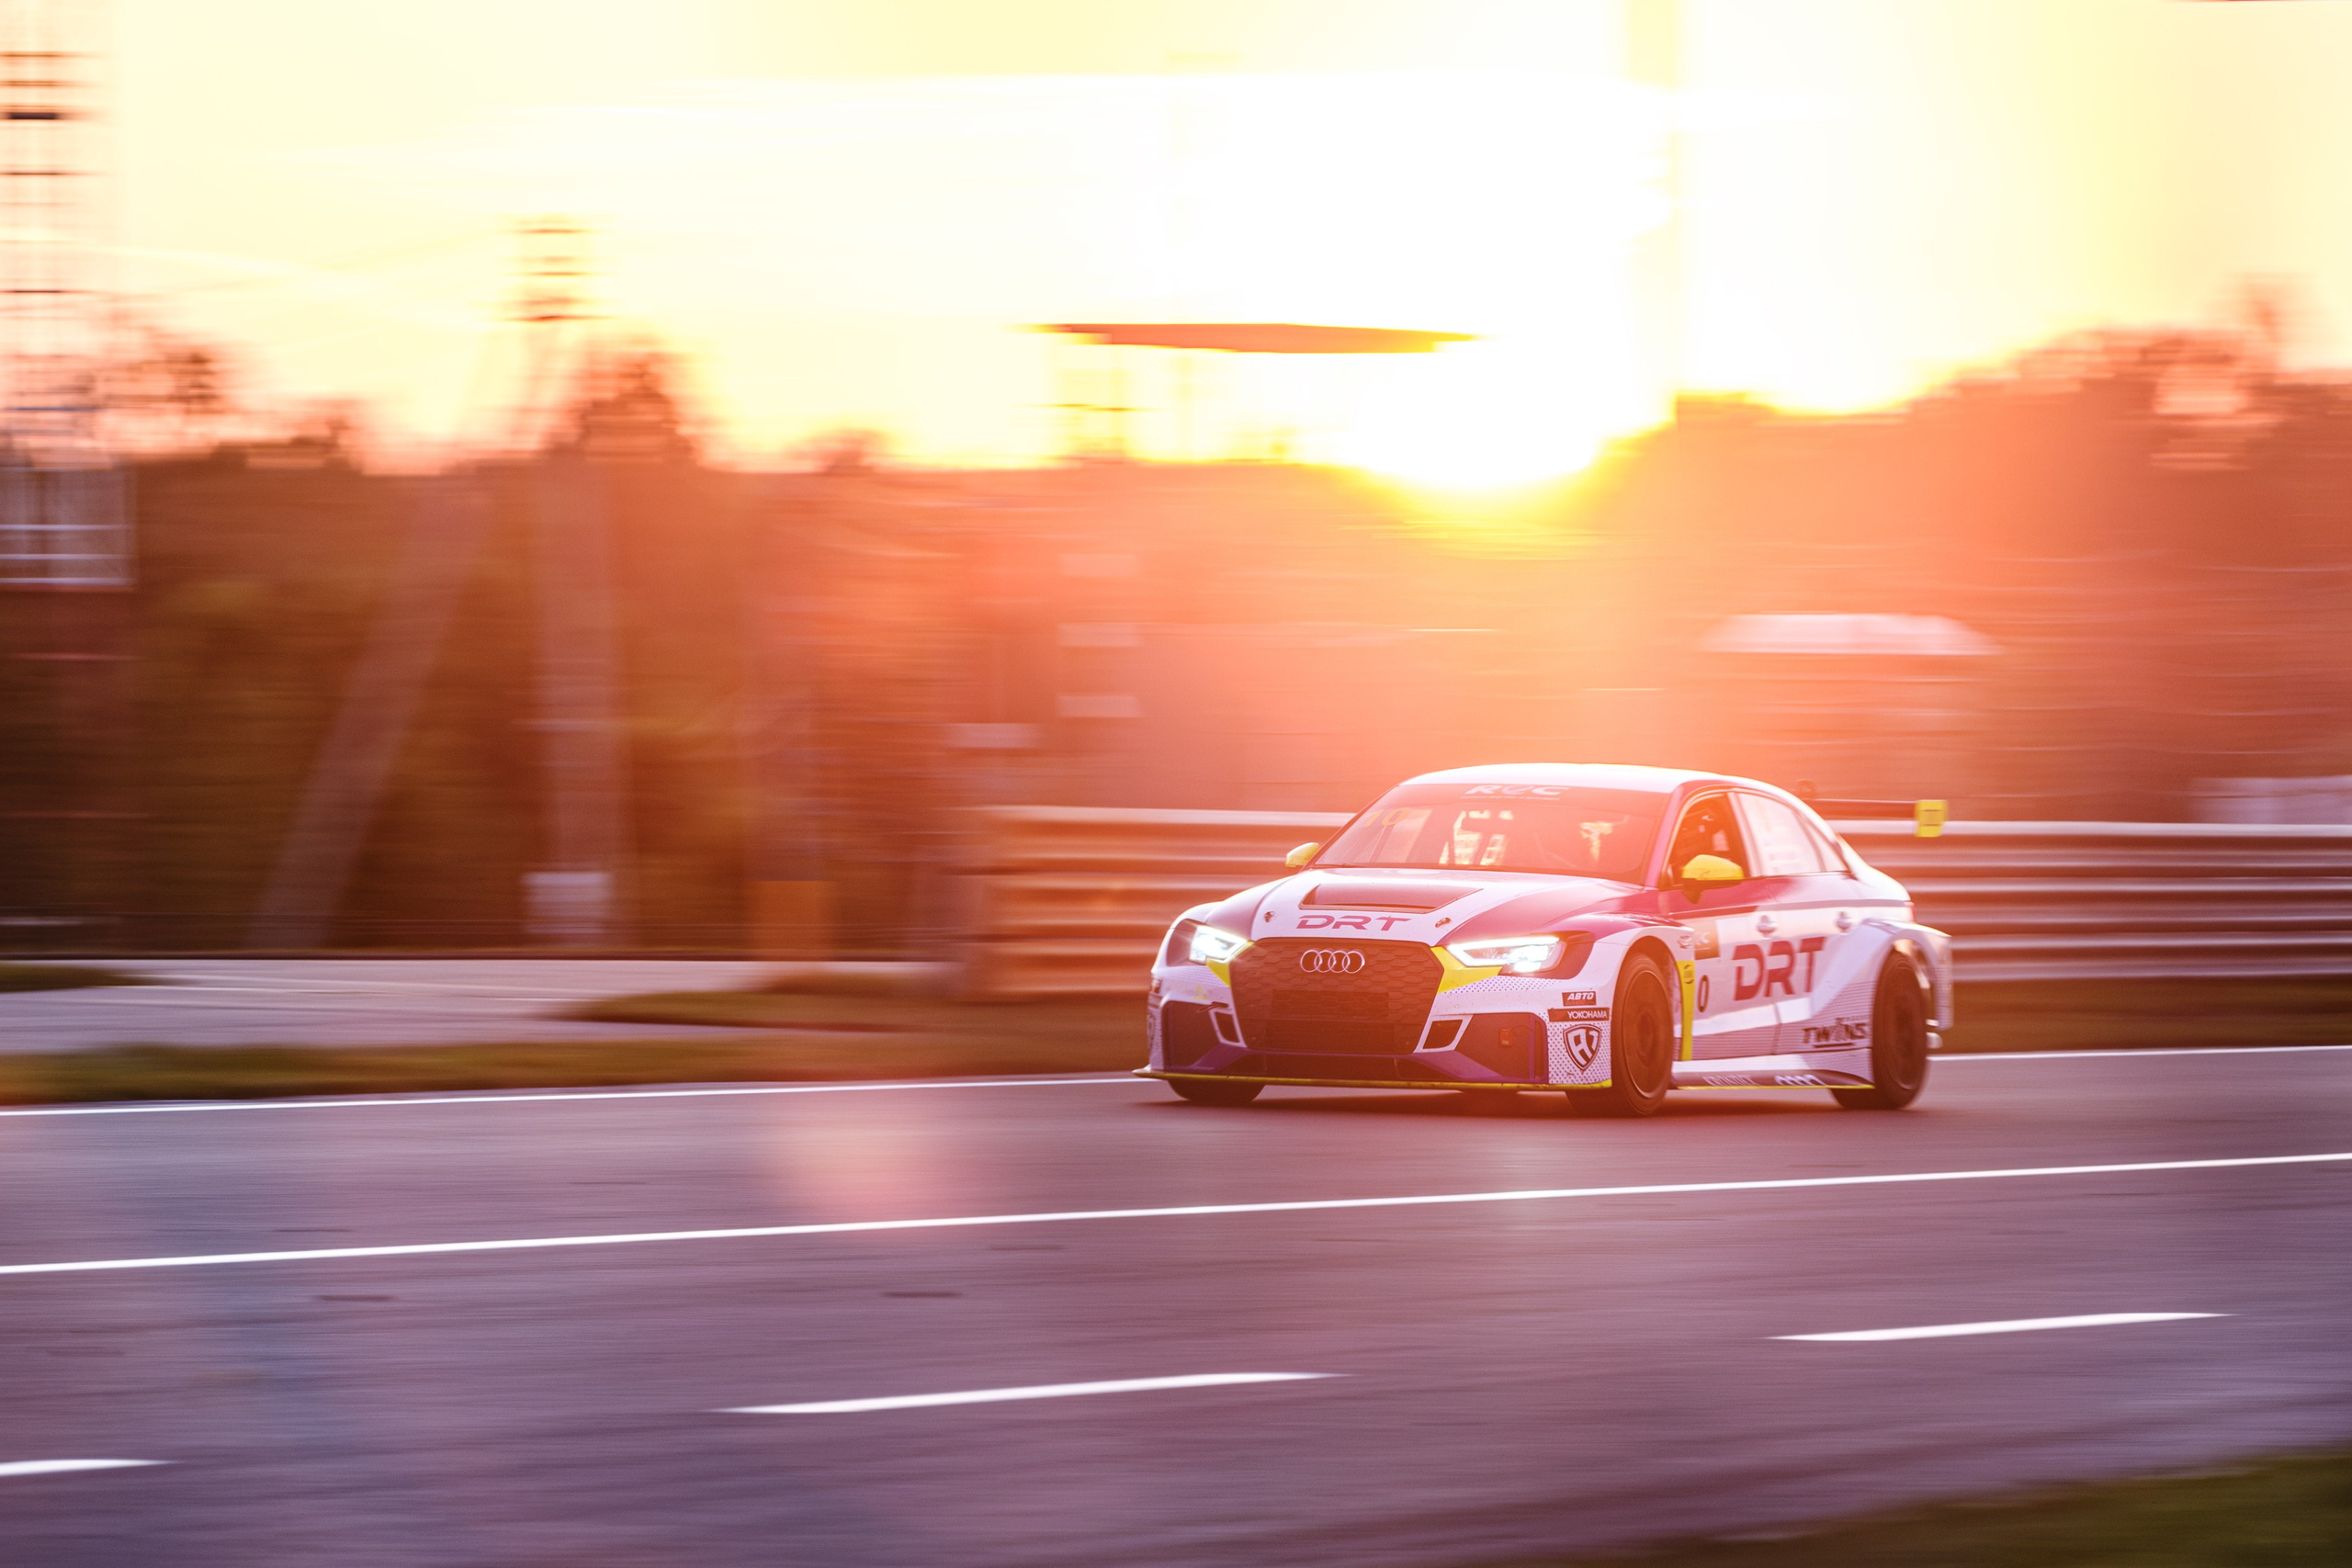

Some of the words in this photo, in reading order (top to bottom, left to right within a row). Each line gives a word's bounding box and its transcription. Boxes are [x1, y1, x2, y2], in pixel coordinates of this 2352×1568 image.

[1363, 807, 1409, 829] 10
[1296, 914, 1413, 931] DRT
[1732, 936, 1827, 1001] DRT
[1566, 1010, 1608, 1020] YOKOHAMA
